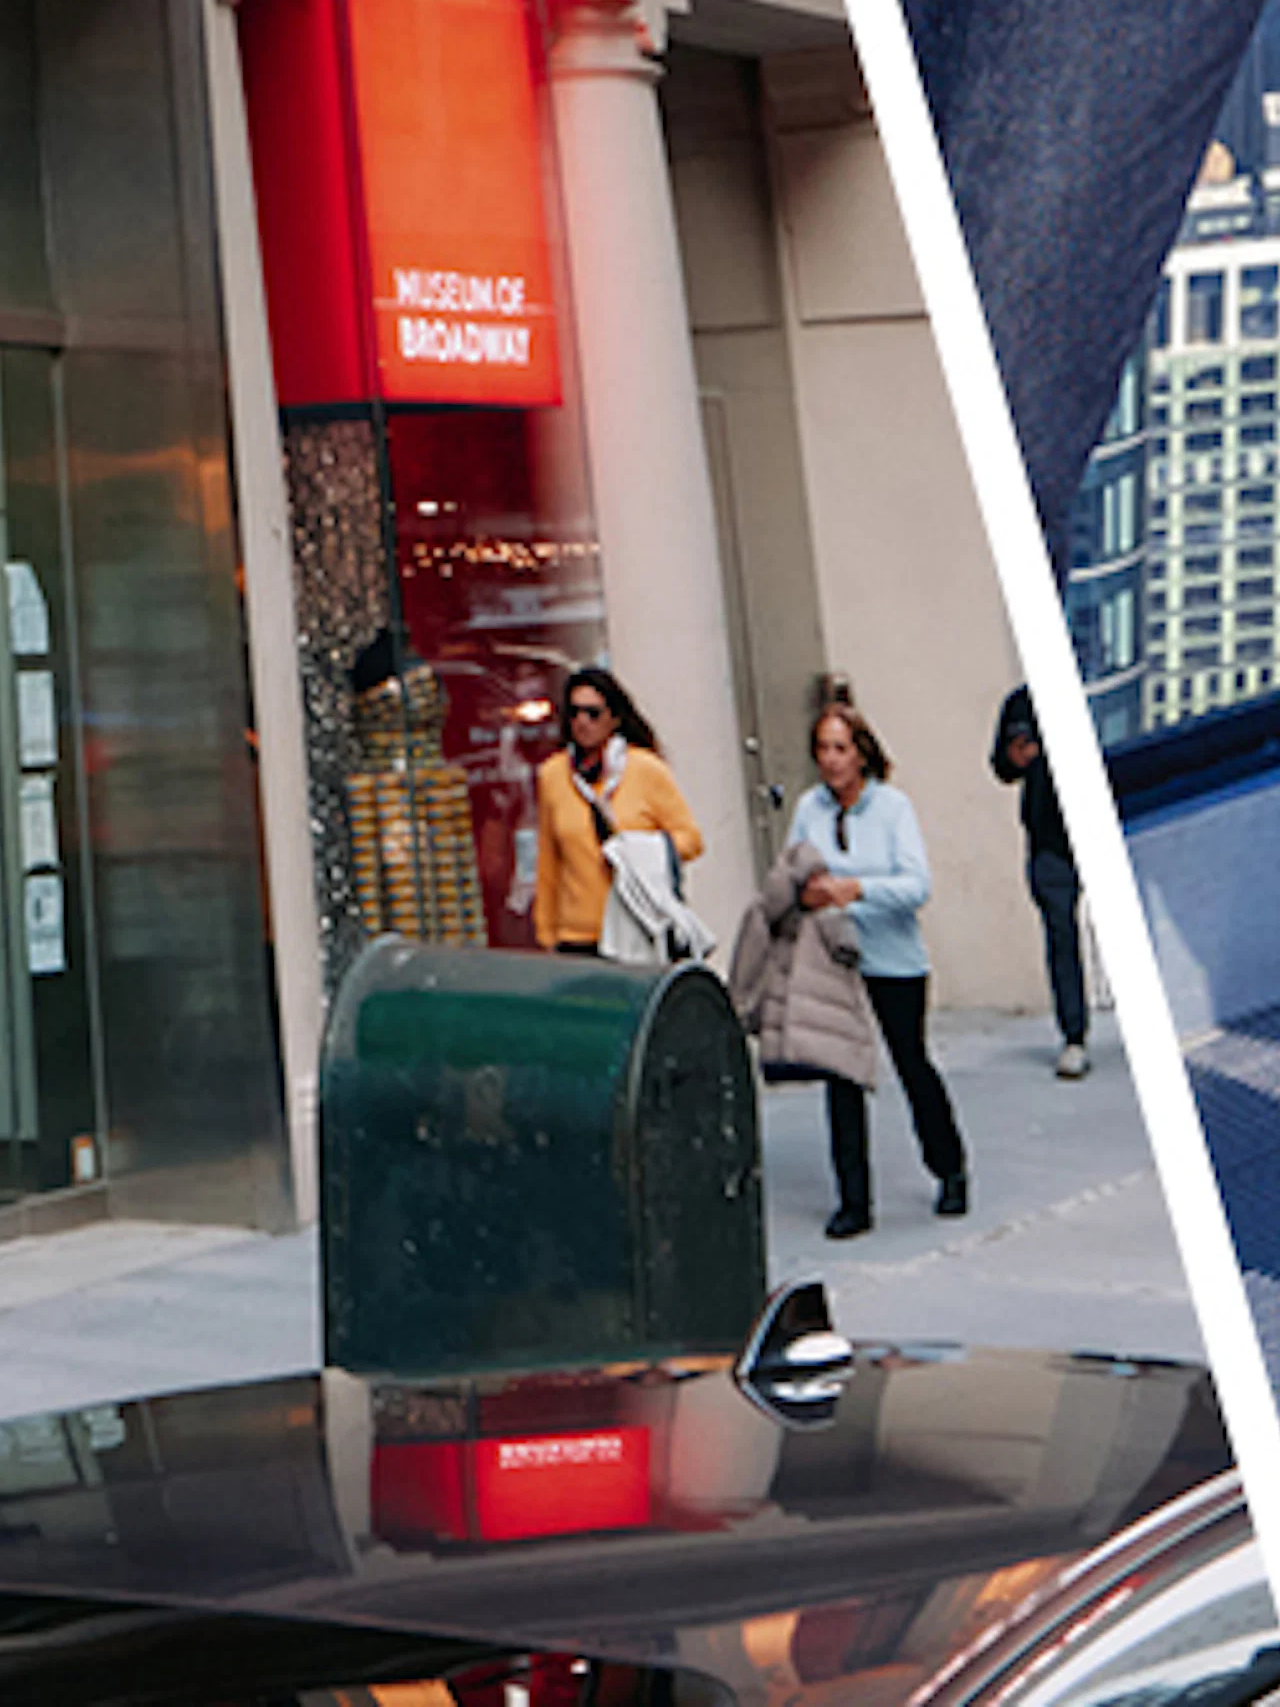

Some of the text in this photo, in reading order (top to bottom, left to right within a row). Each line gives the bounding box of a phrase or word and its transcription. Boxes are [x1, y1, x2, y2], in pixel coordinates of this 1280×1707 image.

[394, 267, 526, 315] MUSEUM OF
[398, 316, 531, 365] BROADWAY
